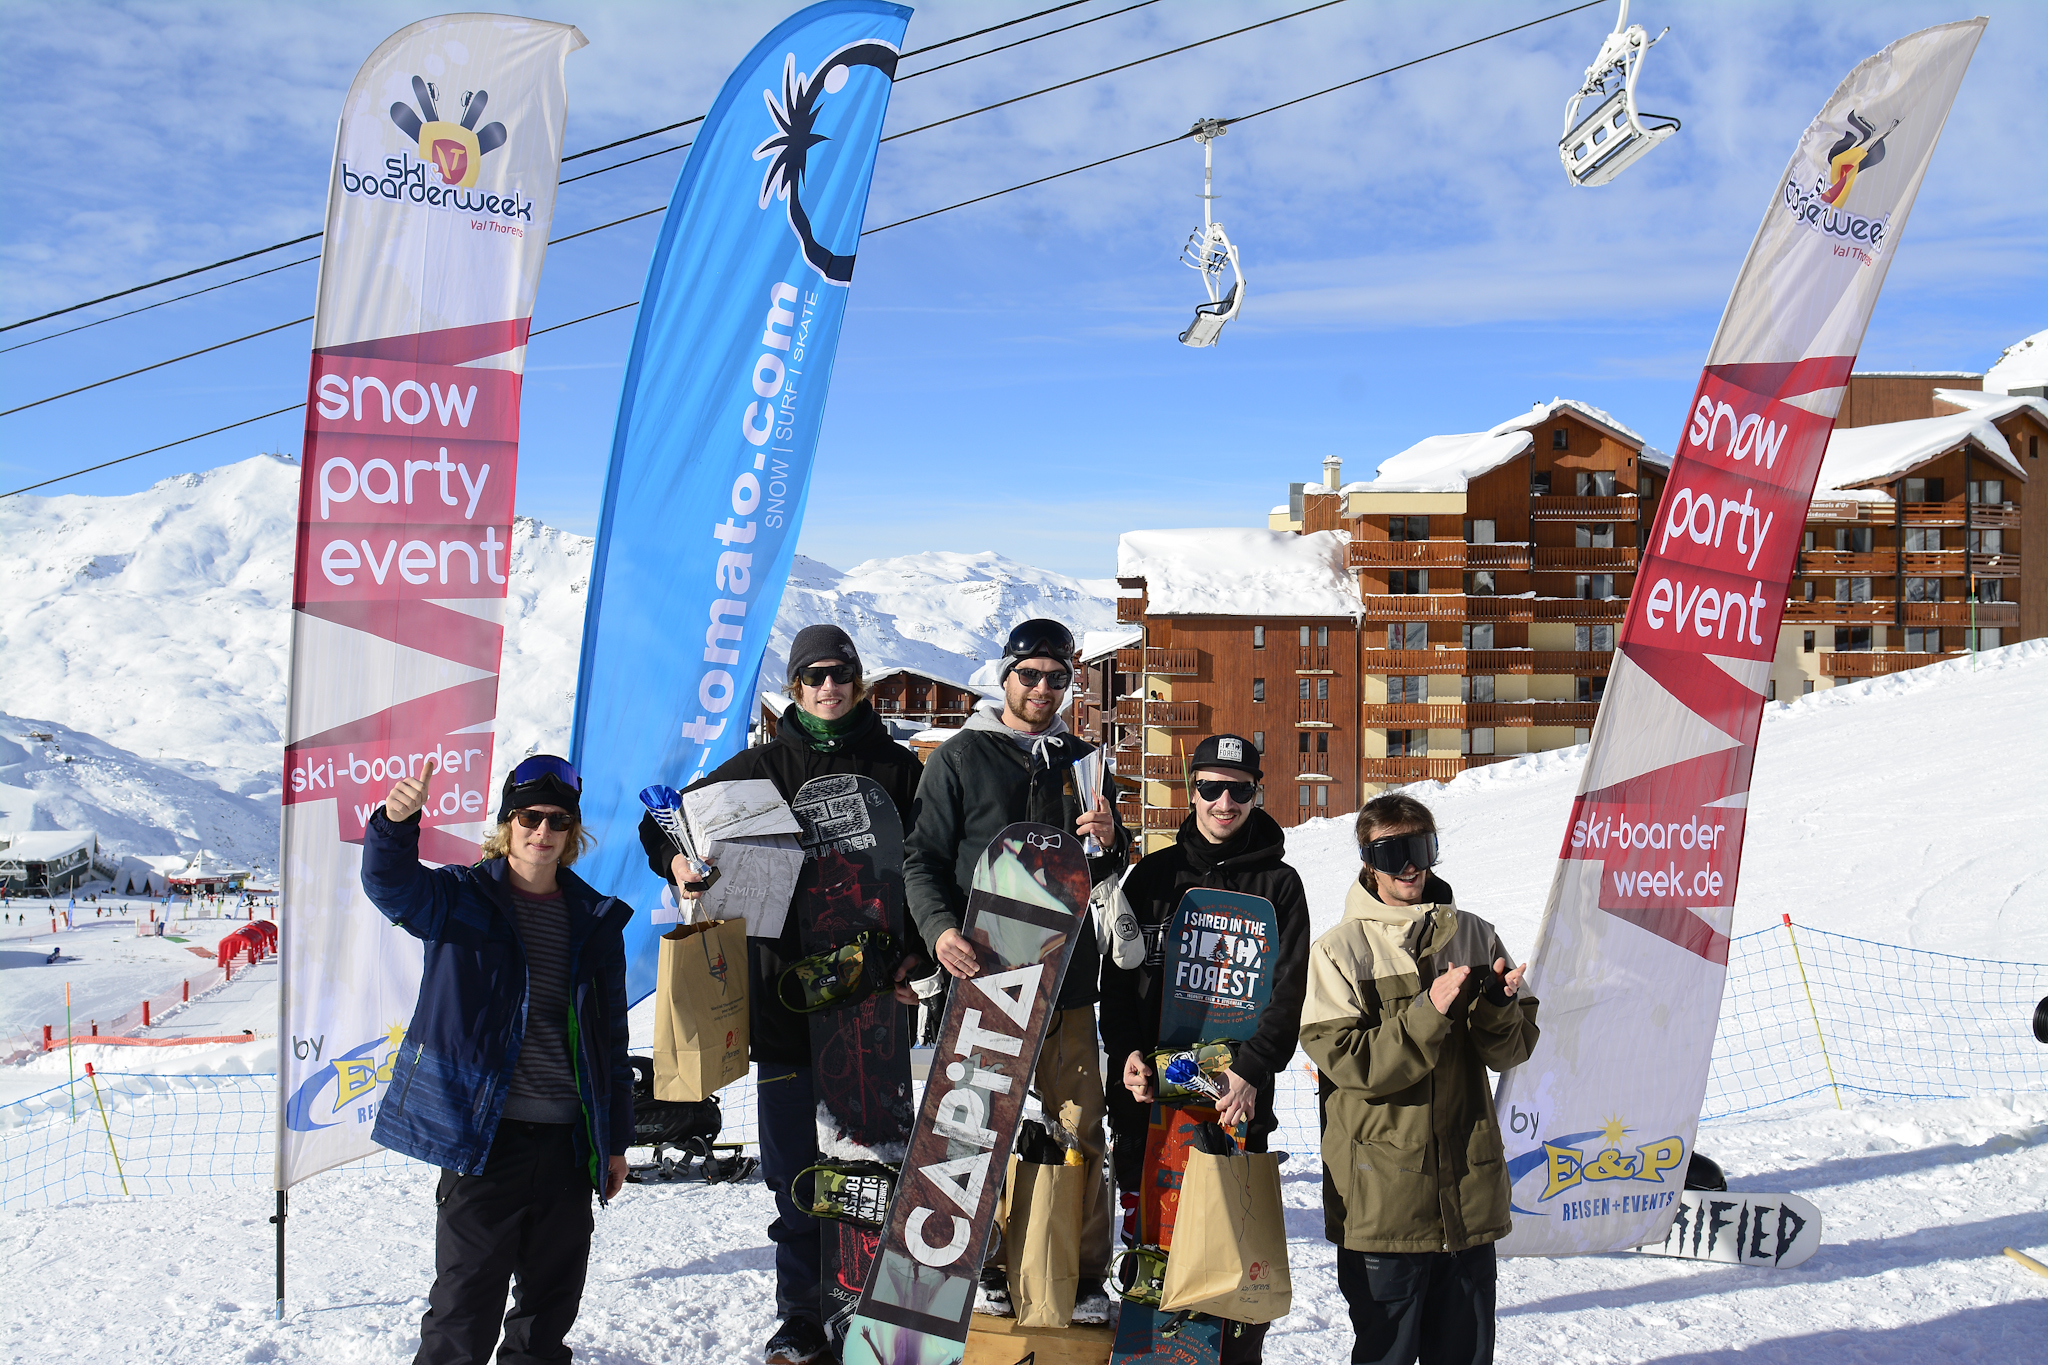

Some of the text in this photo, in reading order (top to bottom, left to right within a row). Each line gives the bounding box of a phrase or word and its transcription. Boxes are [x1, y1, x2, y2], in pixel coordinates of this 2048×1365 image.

[342, 165, 531, 221] boarderweek
[470, 219, 524, 238] Val Thorens
[1833, 244, 1849, 258] Val
[793, 290, 819, 362] SKATE
[316, 373, 478, 428] snow
[775, 379, 798, 441] SURF
[1689, 394, 1788, 469] snow
[319, 446, 491, 520] party
[765, 458, 790, 529] SNOW
[1659, 488, 1774, 571] party
[320, 526, 506, 586] event
[1646, 577, 1767, 645] event
[291, 743, 482, 793] ski-boarder
[354, 783, 484, 828] w.de
[1571, 811, 1726, 850] ski-boarder
[725, 885, 767, 898] SMITH
[1613, 861, 1724, 897] week.de
[1184, 911, 1188, 924] I
[1190, 911, 1228, 931] SHRED
[1229, 917, 1243, 933] IN
[1244, 919, 1267, 936] THE
[292, 1034, 325, 1062] by
[1509, 1104, 1540, 1140] by
[1537, 1135, 1685, 1202] E&P
[1562, 1190, 1675, 1222] REISEN+EVENTS
[1154, 1343, 1172, 1354] THE
